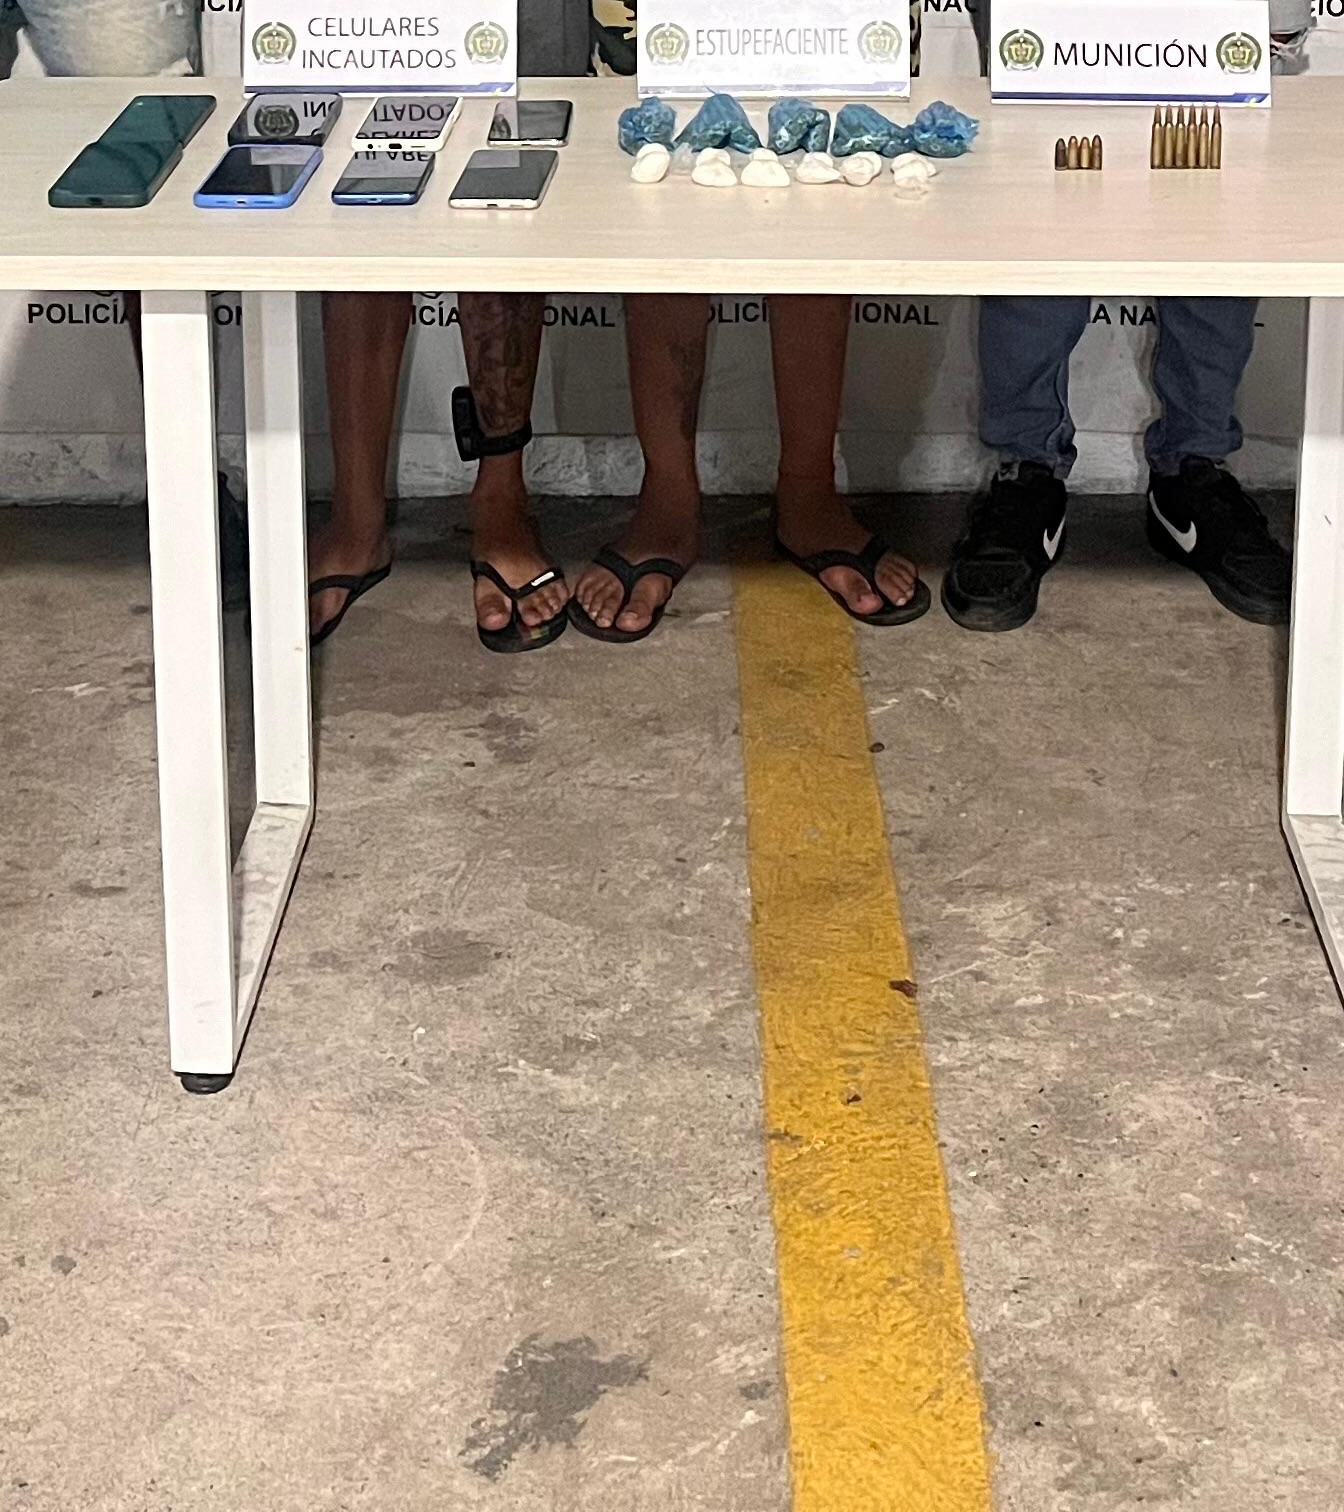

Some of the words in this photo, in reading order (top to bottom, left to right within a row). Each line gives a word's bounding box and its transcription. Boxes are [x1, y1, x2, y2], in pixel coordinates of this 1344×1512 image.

[307, 17, 440, 37] CELULARES
[695, 28, 849, 57] ESTUPEFACIENTE
[1054, 36, 1208, 68] MUNICIÓN
[302, 49, 457, 69] INCAUTADOS
[856, 302, 939, 326] IONAL
